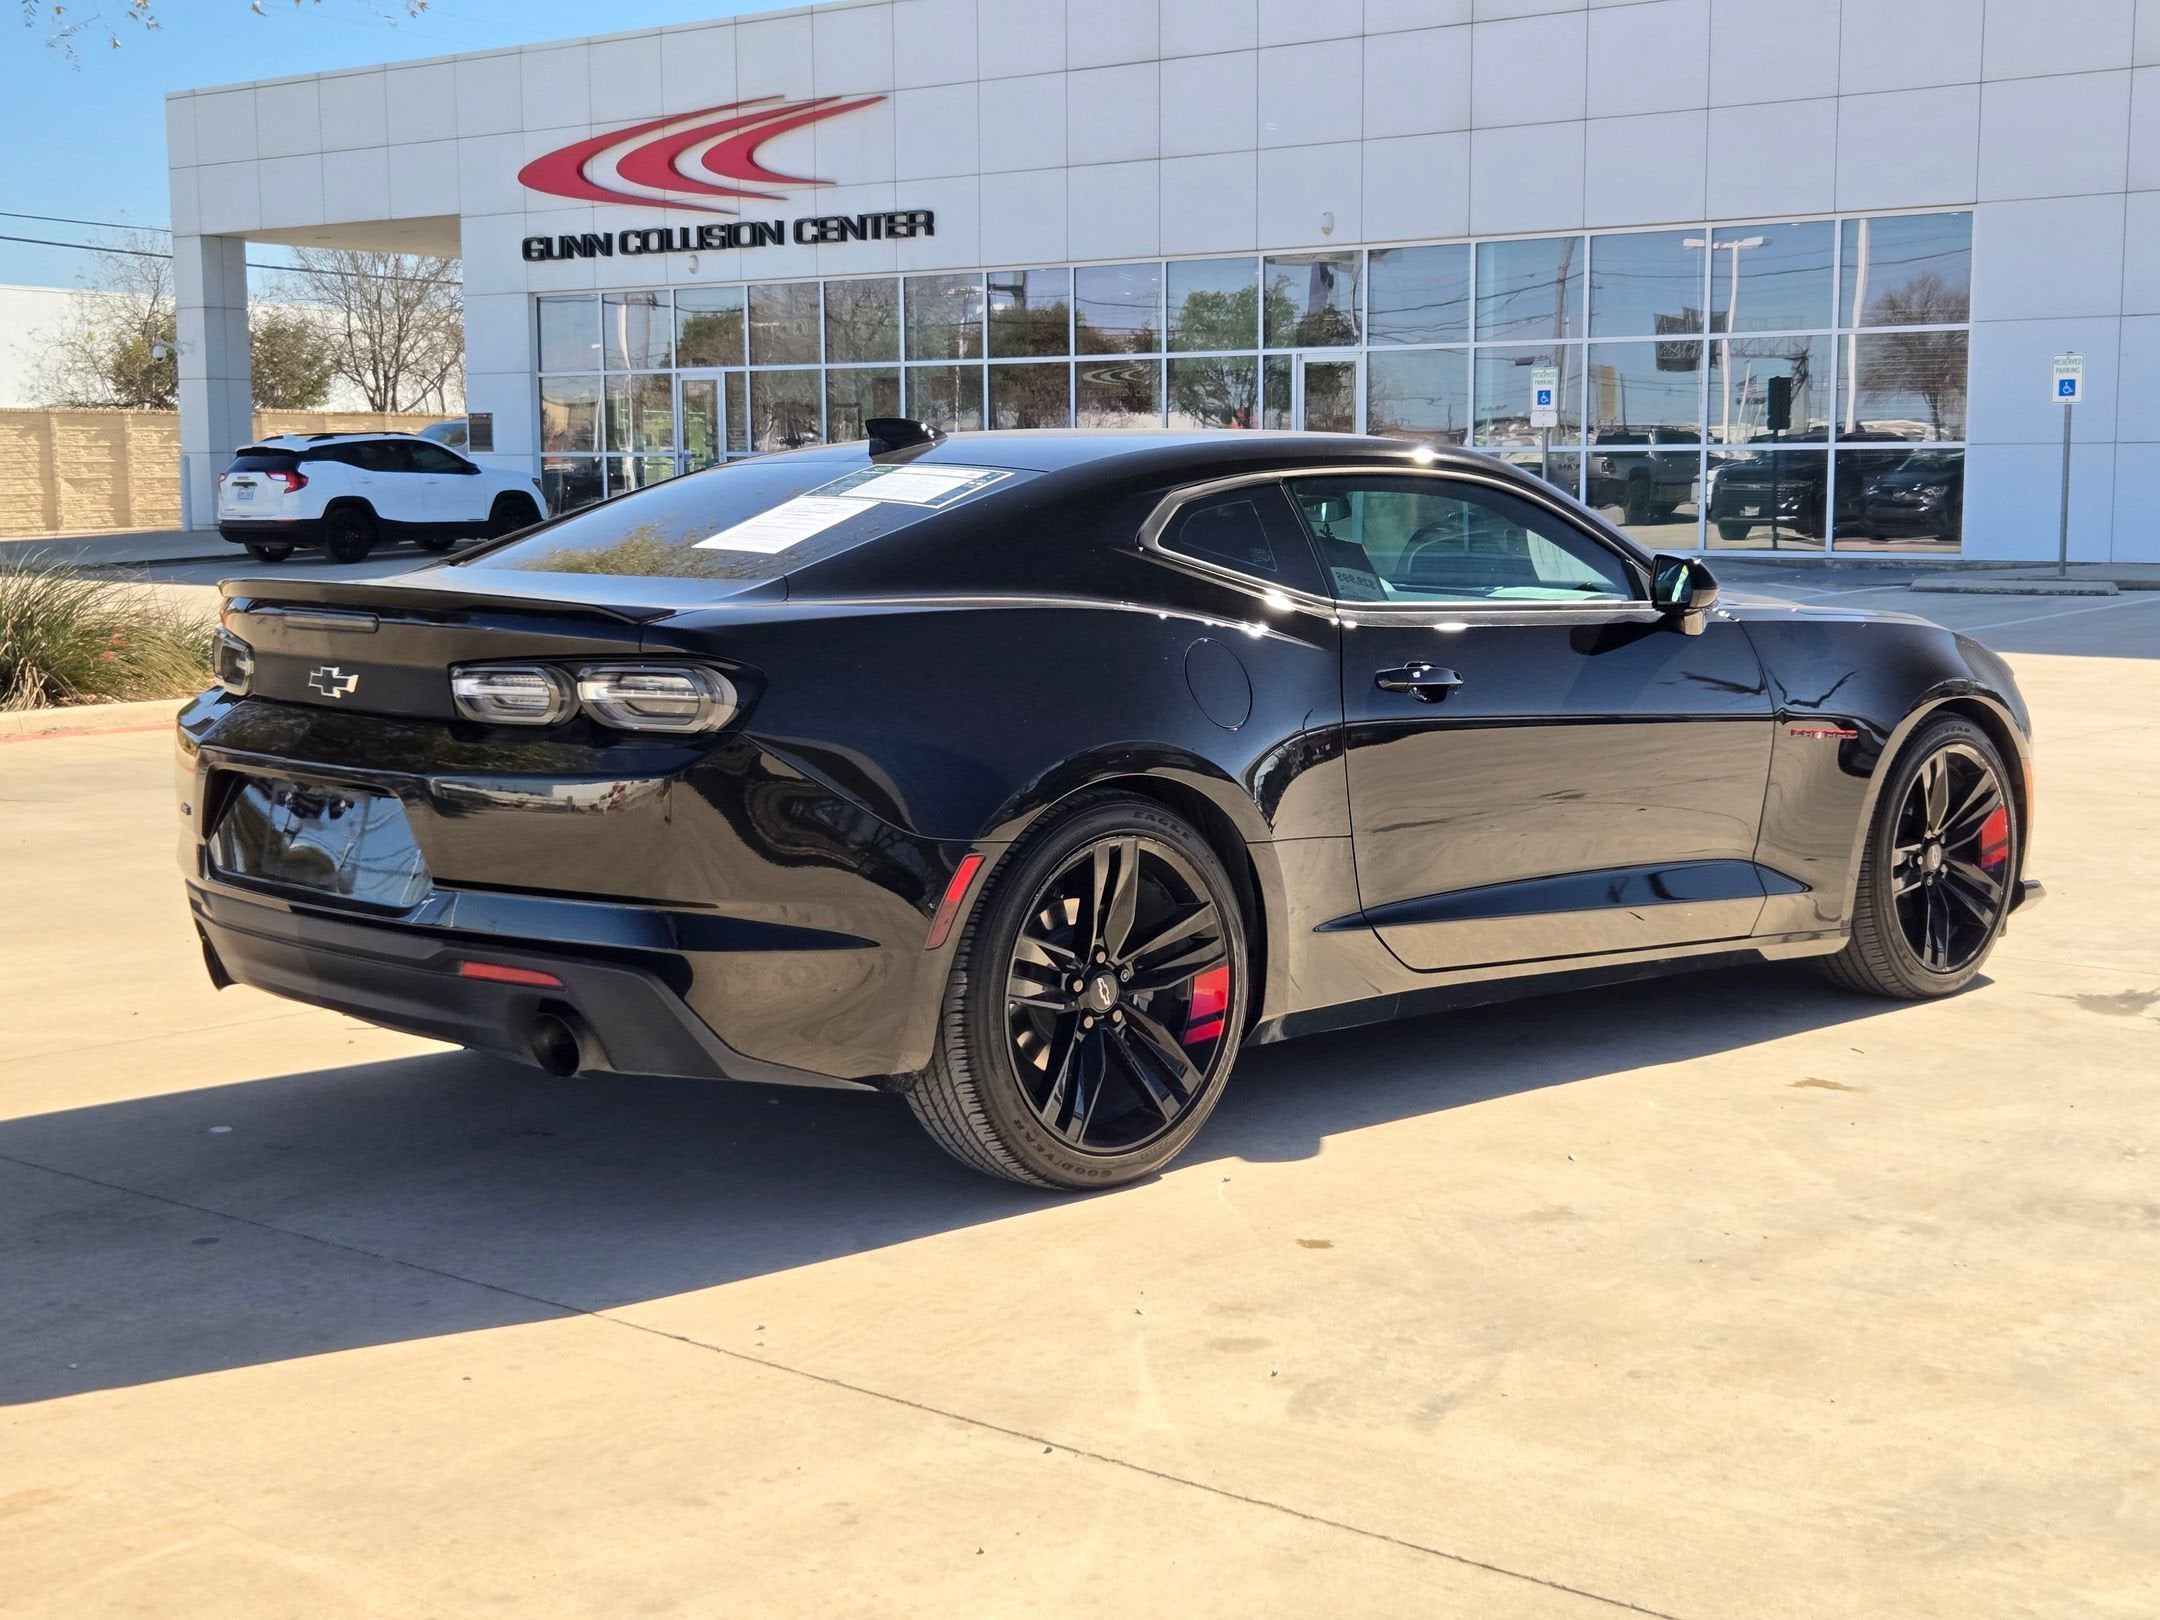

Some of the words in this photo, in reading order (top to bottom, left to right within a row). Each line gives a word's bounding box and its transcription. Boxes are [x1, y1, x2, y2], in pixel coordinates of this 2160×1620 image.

[522, 232, 613, 261] GUNN
[618, 220, 785, 255] COLLISION
[793, 209, 935, 245] CENTER
[2055, 366, 2080, 374] PARKING
[1133, 811, 1192, 840] EAGLE
[1014, 1119, 1112, 1178] GOODYEAR
